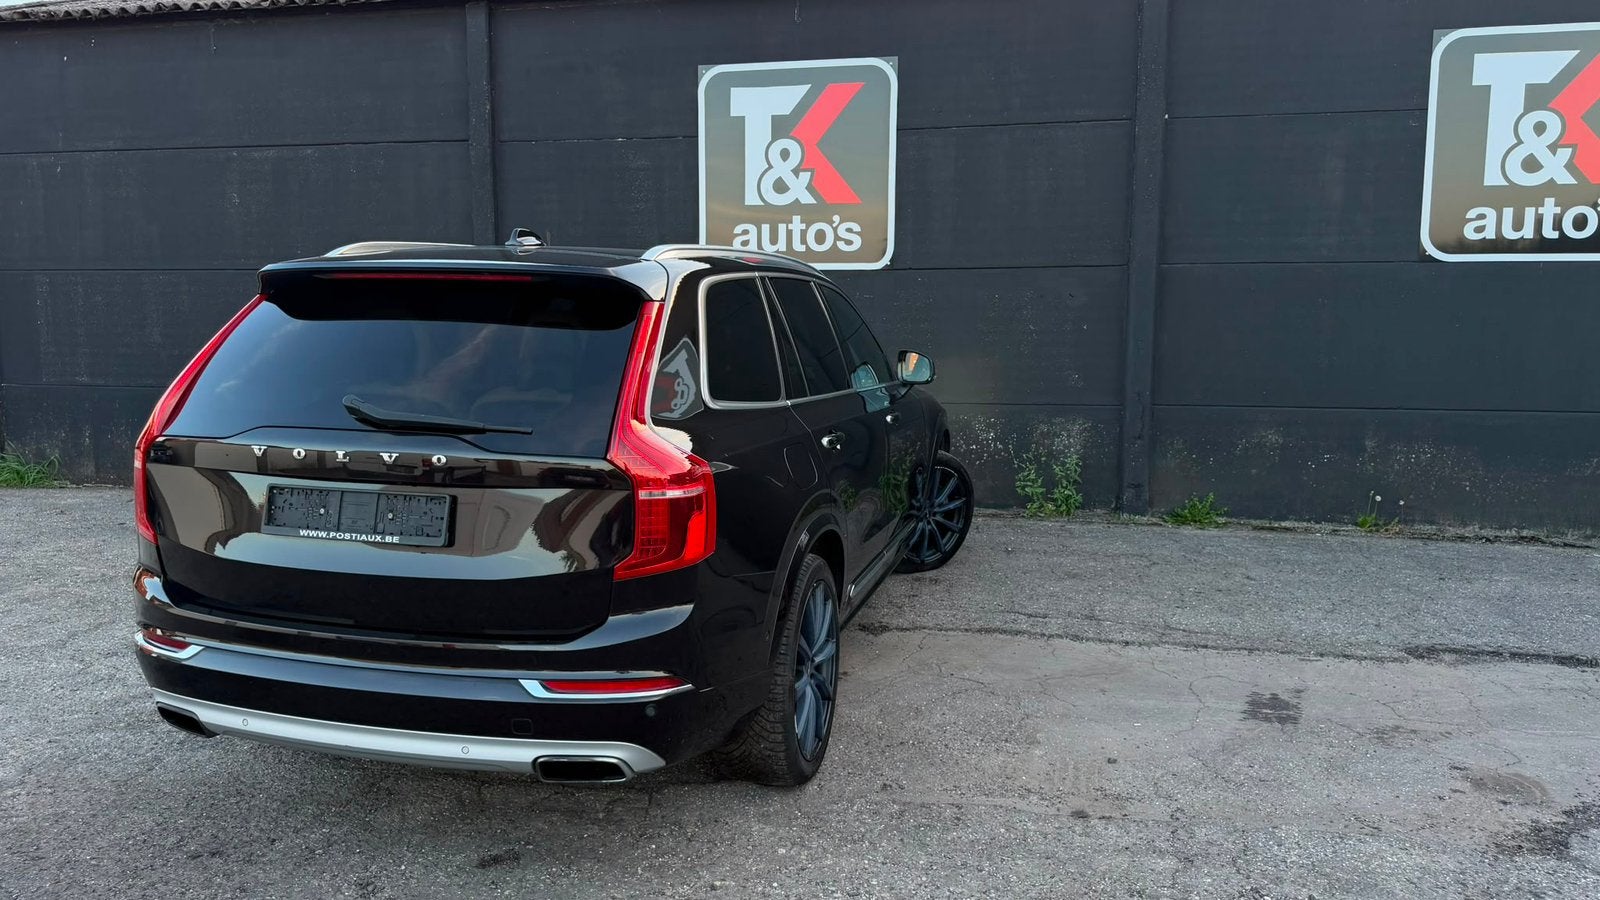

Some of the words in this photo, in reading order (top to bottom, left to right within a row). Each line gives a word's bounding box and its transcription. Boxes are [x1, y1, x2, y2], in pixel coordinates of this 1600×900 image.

[730, 82, 865, 206] T&K
[732, 214, 862, 253] auto's
[1463, 197, 1600, 240] auto
[251, 445, 447, 467] VOLVO
[299, 529, 400, 543] WWW.POSTIAUX.BE
